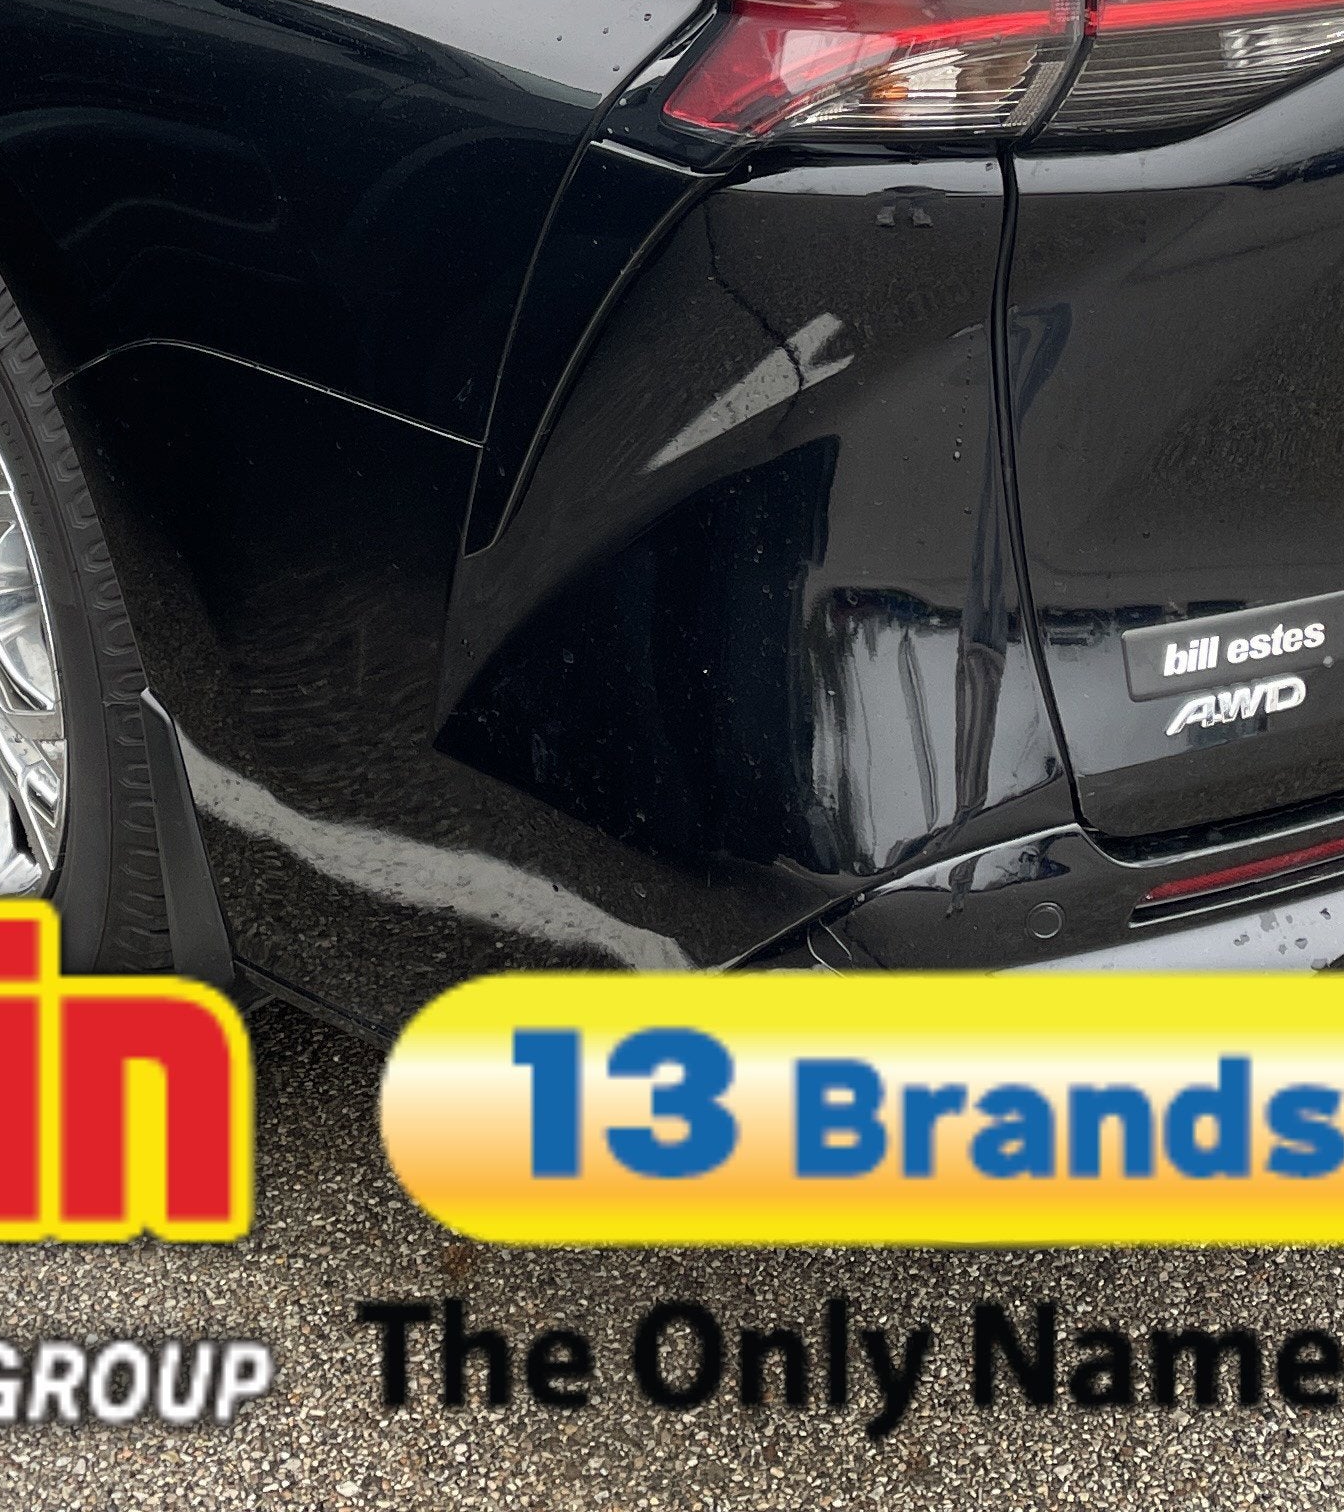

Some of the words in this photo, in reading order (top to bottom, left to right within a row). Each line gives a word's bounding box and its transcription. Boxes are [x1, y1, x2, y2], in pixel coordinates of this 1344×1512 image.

[1163, 635, 1220, 677] bill
[1227, 623, 1325, 664] estes
[1165, 674, 1307, 736] AWD
